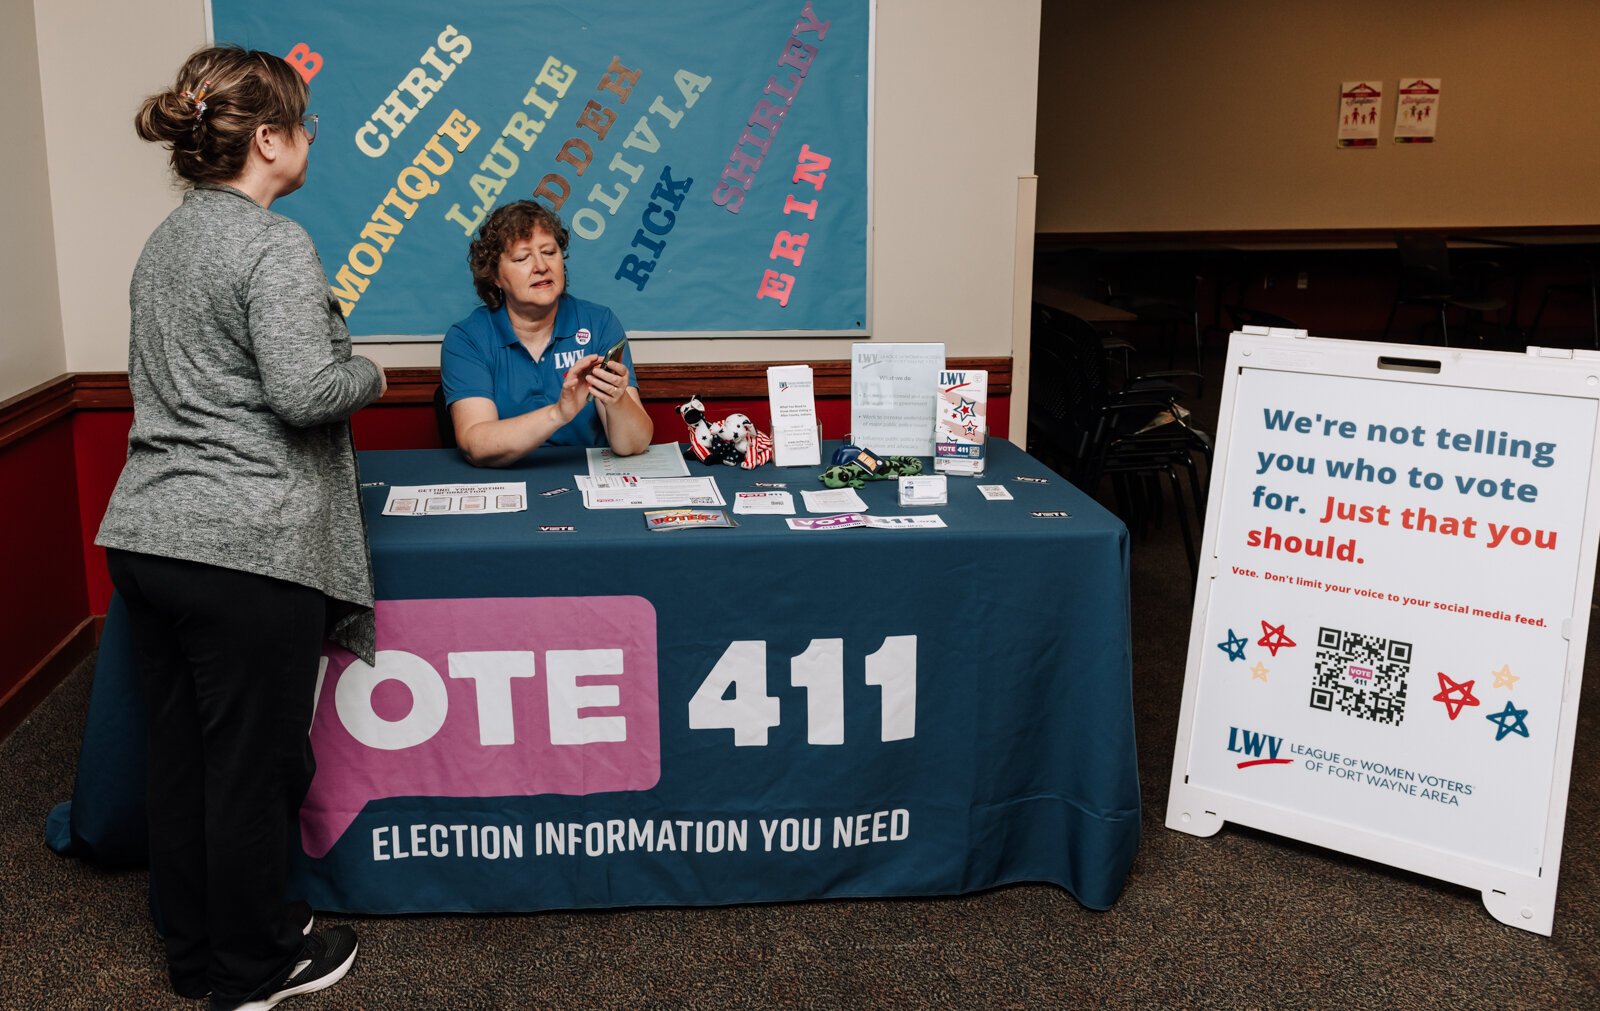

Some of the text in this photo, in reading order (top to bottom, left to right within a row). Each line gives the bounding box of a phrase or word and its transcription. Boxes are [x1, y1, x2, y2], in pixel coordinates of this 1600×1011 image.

[354, 24, 473, 159] CHRIS
[711, 0, 832, 215] SHIRLEY
[444, 55, 578, 238] LAURIE
[571, 68, 712, 241] OLIVIA
[330, 108, 482, 318] MONIQUE
[614, 165, 694, 292] RICK
[756, 143, 832, 308] ERIN
[858, 353, 879, 364] LWV
[941, 372, 966, 385] LWV
[1263, 407, 1557, 468] We're not telling
[1255, 450, 1539, 503] you who to vote
[1246, 526, 1365, 565] should.
[1252, 485, 1558, 550] for. Just that you
[1231, 566, 1547, 628] Vote. Don't limit your voice to your social media feed.
[308, 634, 918, 751] OTE 411
[1350, 668, 1371, 678] VOTE
[1226, 726, 1284, 760] LWV
[1290, 743, 1341, 764] LEAGUE
[1342, 757, 1358, 767] OF
[1360, 760, 1415, 781] WOMEN
[1304, 759, 1460, 806] OF FORT WAYNE AREA
[372, 808, 910, 861] ELECTION INFORMATION YOU NEED
